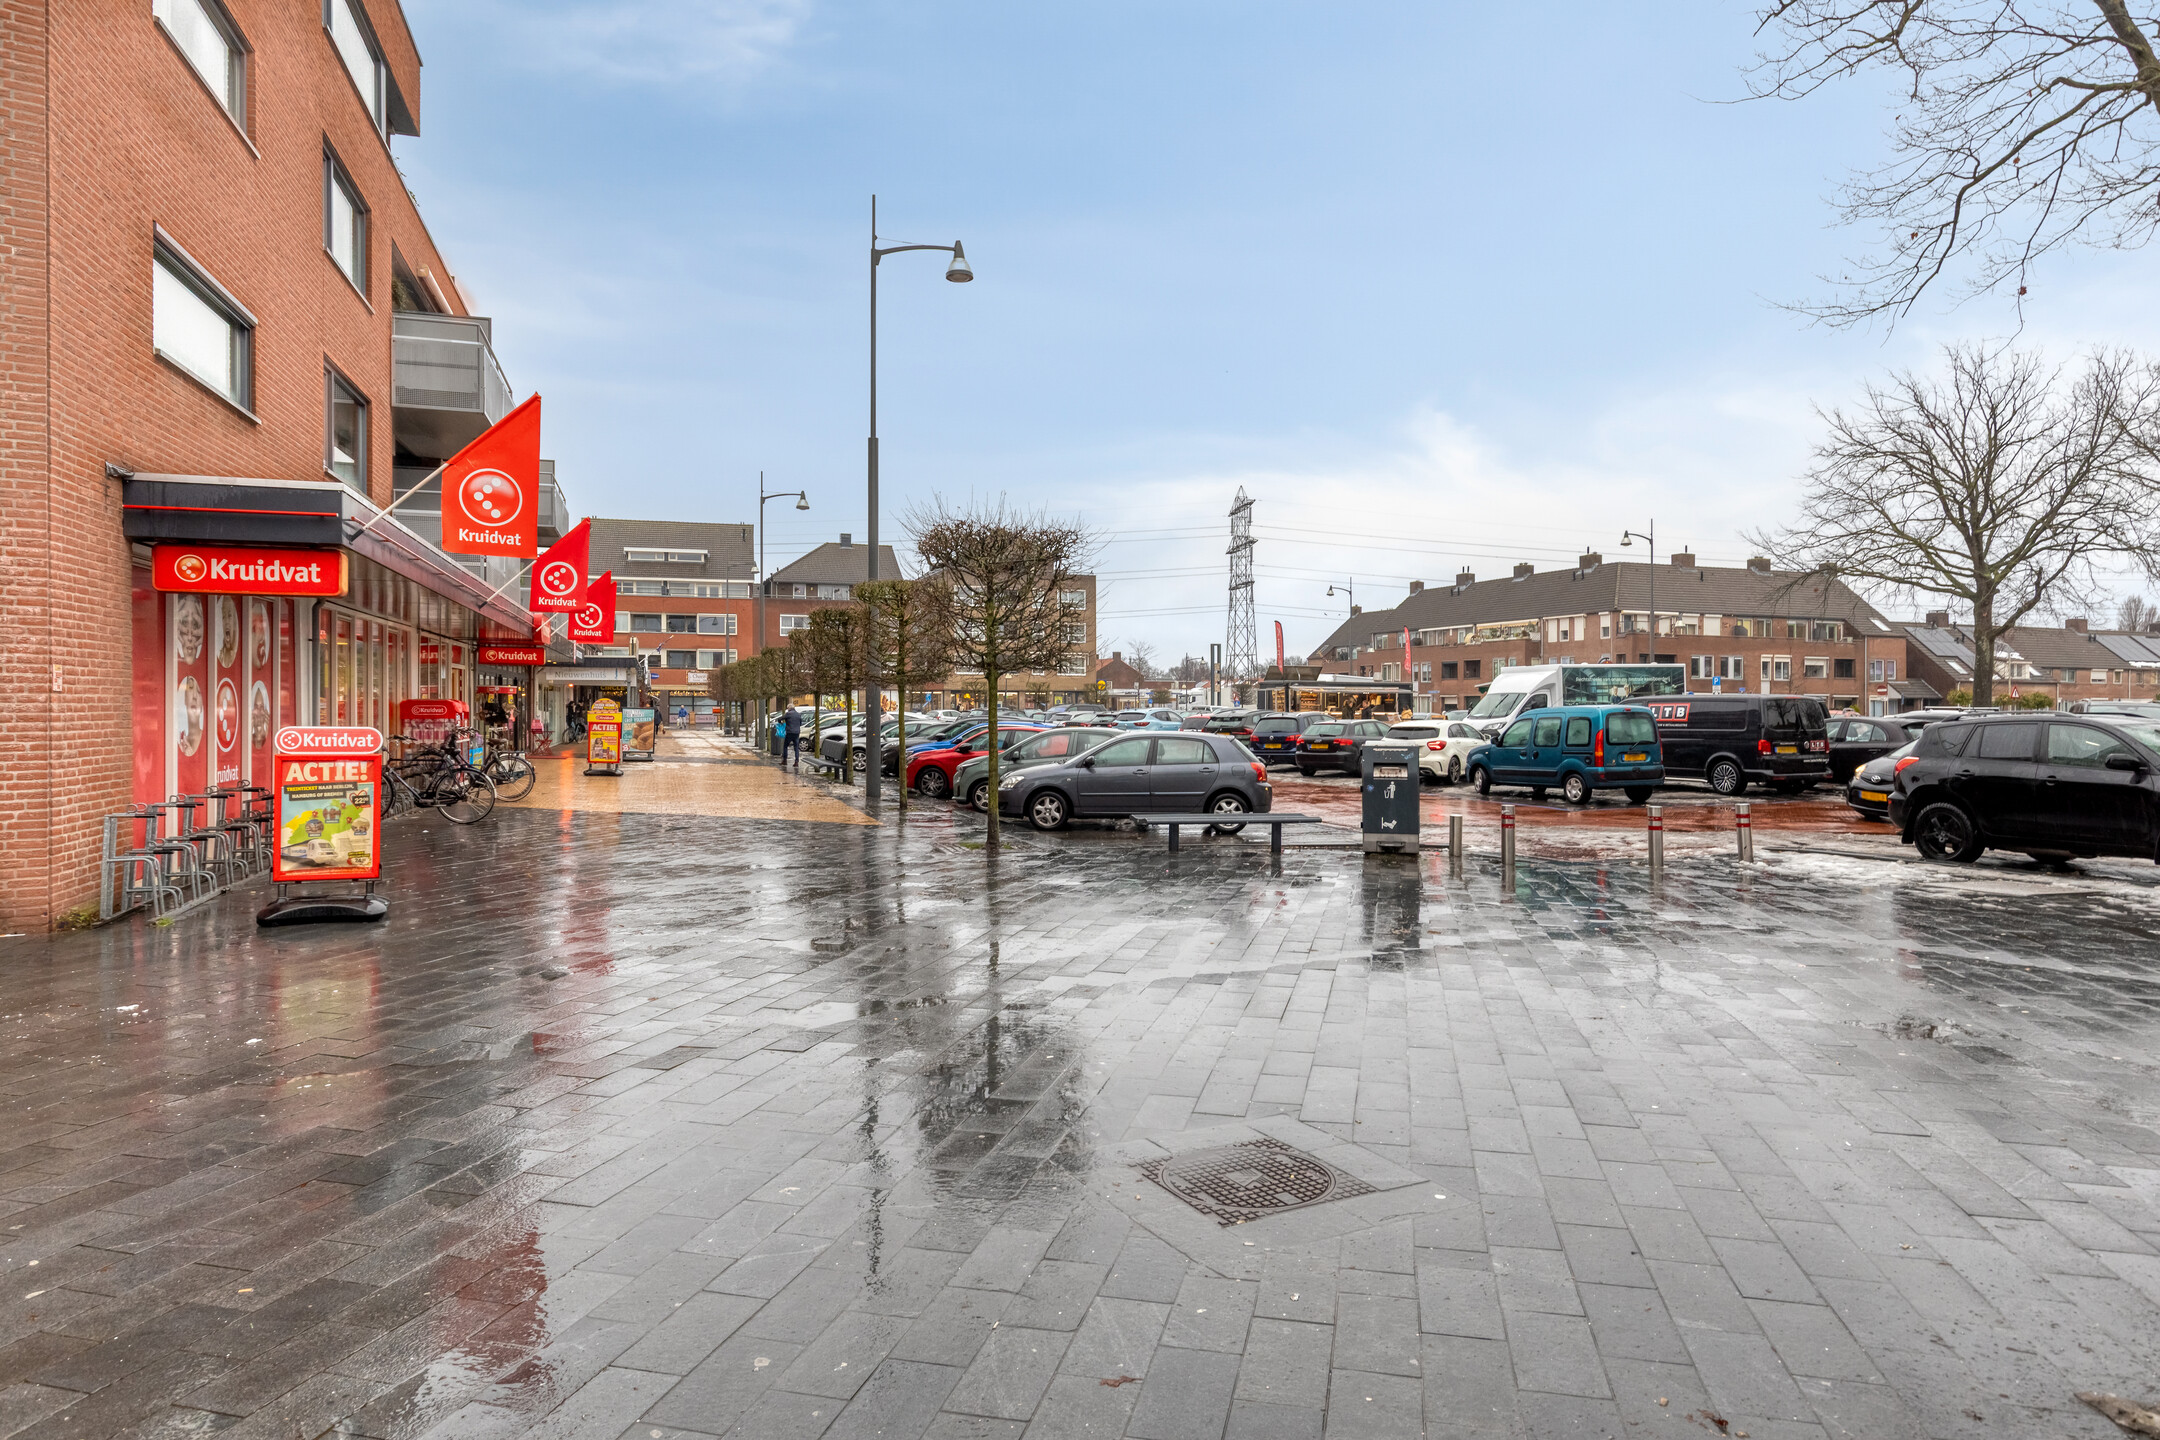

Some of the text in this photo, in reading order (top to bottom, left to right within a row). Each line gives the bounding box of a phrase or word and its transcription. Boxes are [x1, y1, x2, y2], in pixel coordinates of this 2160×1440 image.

[458, 528, 521, 546] Kruidvat
[211, 558, 321, 583] Kruidvat
[538, 596, 577, 607] Kruidvat
[573, 628, 602, 637] Kruidvat
[498, 651, 537, 661] Kruidvat
[554, 670, 606, 679] Nieuwenhuis
[303, 733, 374, 747] Kruidvat
[285, 762, 368, 782] ACTIE!
